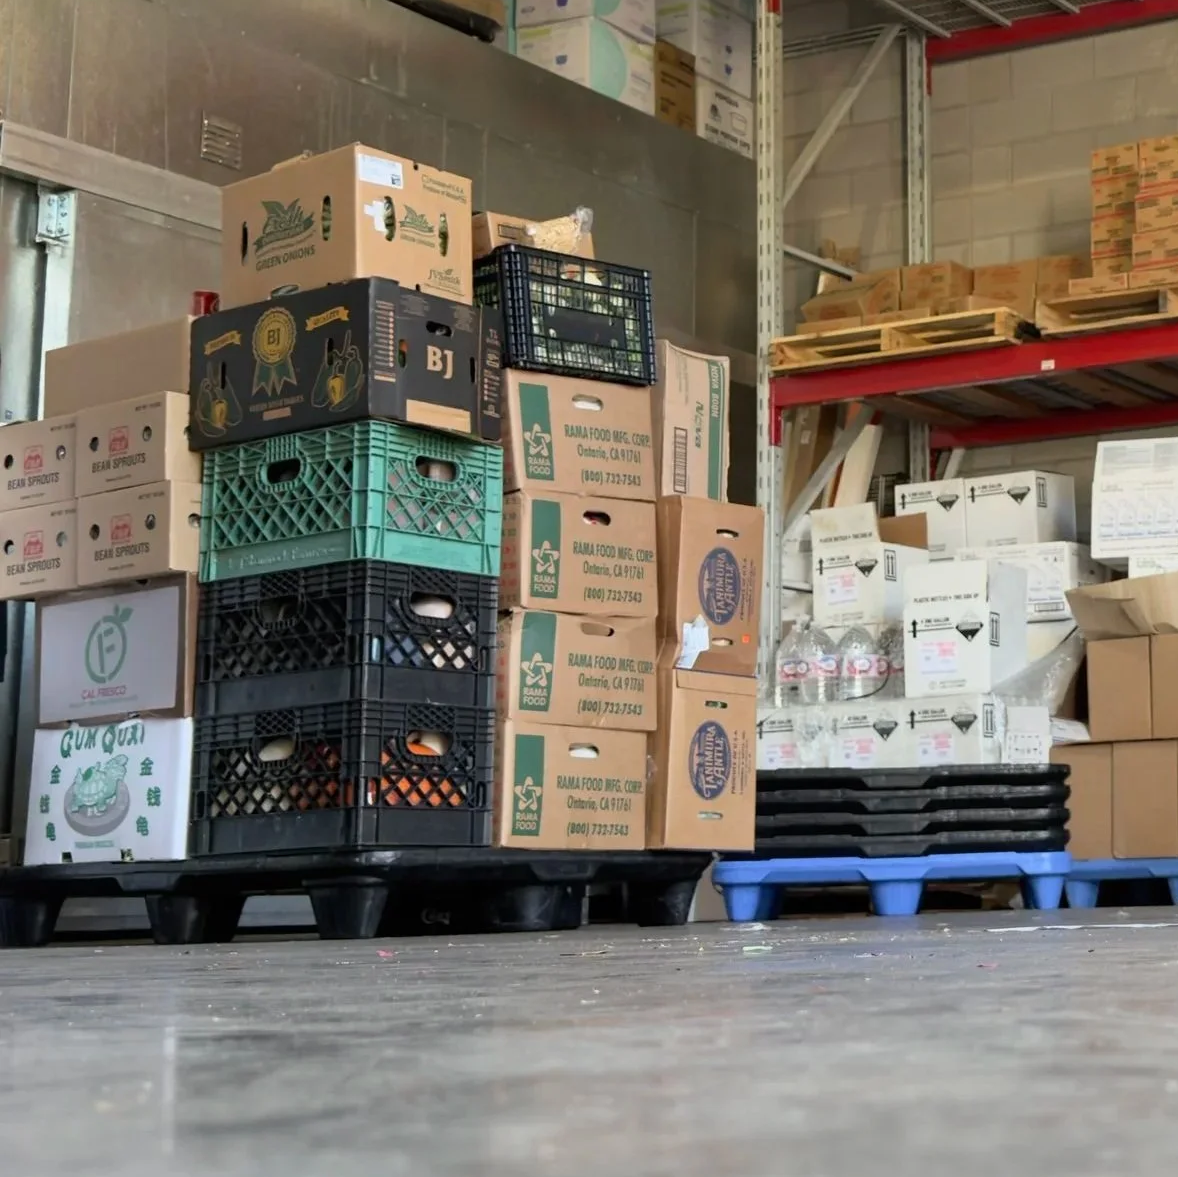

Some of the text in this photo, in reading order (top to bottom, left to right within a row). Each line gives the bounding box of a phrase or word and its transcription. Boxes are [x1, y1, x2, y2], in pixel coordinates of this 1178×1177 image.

[256, 243, 317, 272] GREEN ONIONS
[267, 328, 281, 346] BJ
[426, 345, 455, 380] BJ
[564, 424, 588, 439] RAMA
[590, 427, 612, 442] FOOD
[91, 452, 147, 474] BEAN SPROUTS
[527, 456, 551, 466] RAMA
[609, 447, 621, 460] CA
[620, 449, 641, 464] 91761
[528, 465, 551, 475] FOOD
[581, 468, 604, 487] (800)
[7, 472, 60, 491] BEAN SPROUTS
[93, 541, 150, 562] BEAN SPROUTS
[573, 541, 595, 556] RAMA
[596, 544, 616, 558] FOOD
[6, 557, 61, 577] BEAN SPROUTS
[613, 563, 623, 578] CA
[623, 565, 645, 580] 91761
[533, 583, 555, 593] FOOD
[583, 587, 643, 604] (800) 732-7543
[710, 552, 729, 622] TANIMURA
[568, 652, 593, 669] RAMA
[593, 655, 617, 671] FOOD
[612, 676, 623, 691] CA
[522, 696, 547, 706] FOOD
[577, 698, 643, 716] (800) 732-7543
[700, 725, 718, 798] TANIMURA
[713, 737, 727, 781] ANTLE
[556, 775, 582, 790] RAMA
[582, 777, 603, 792] FOOD
[599, 797, 610, 811] CA
[515, 821, 537, 830] FOOD
